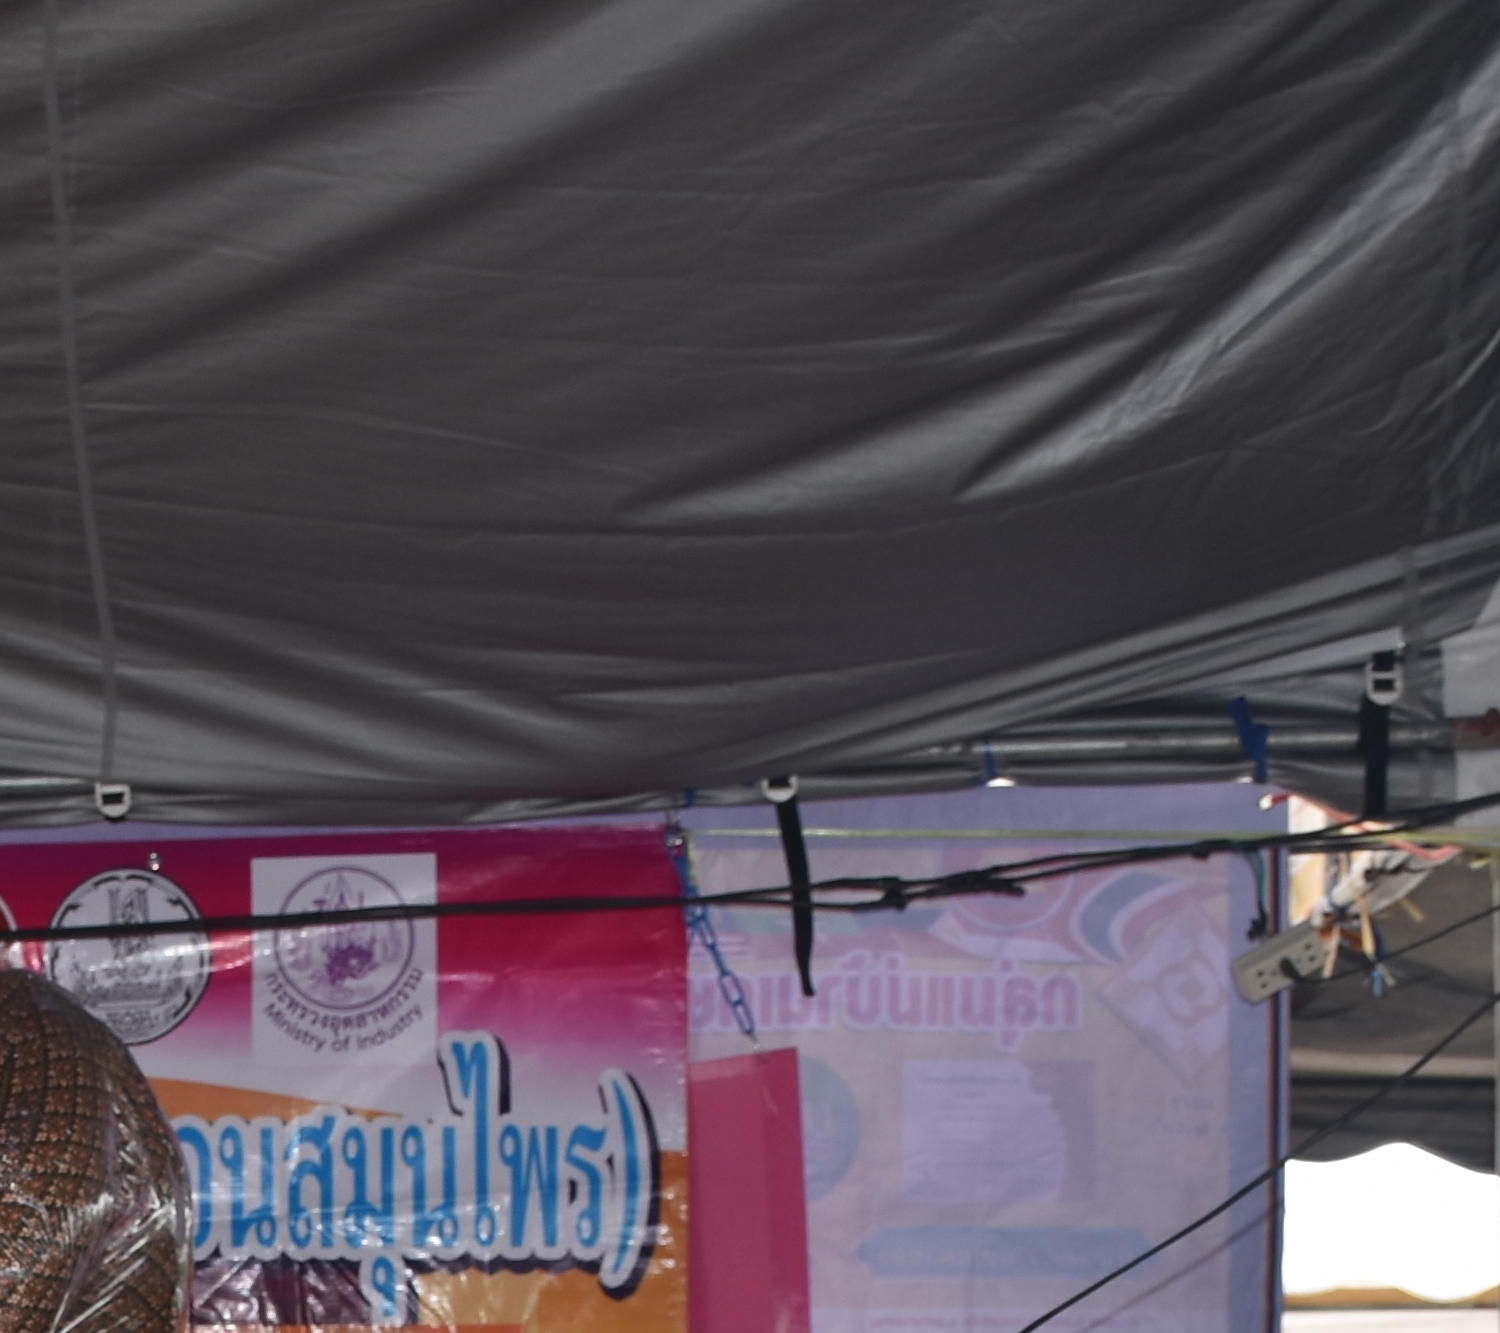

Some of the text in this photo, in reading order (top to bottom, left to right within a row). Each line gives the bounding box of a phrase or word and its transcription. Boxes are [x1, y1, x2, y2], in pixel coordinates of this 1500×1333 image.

[264, 1002, 424, 1052] Ministry of Industry
